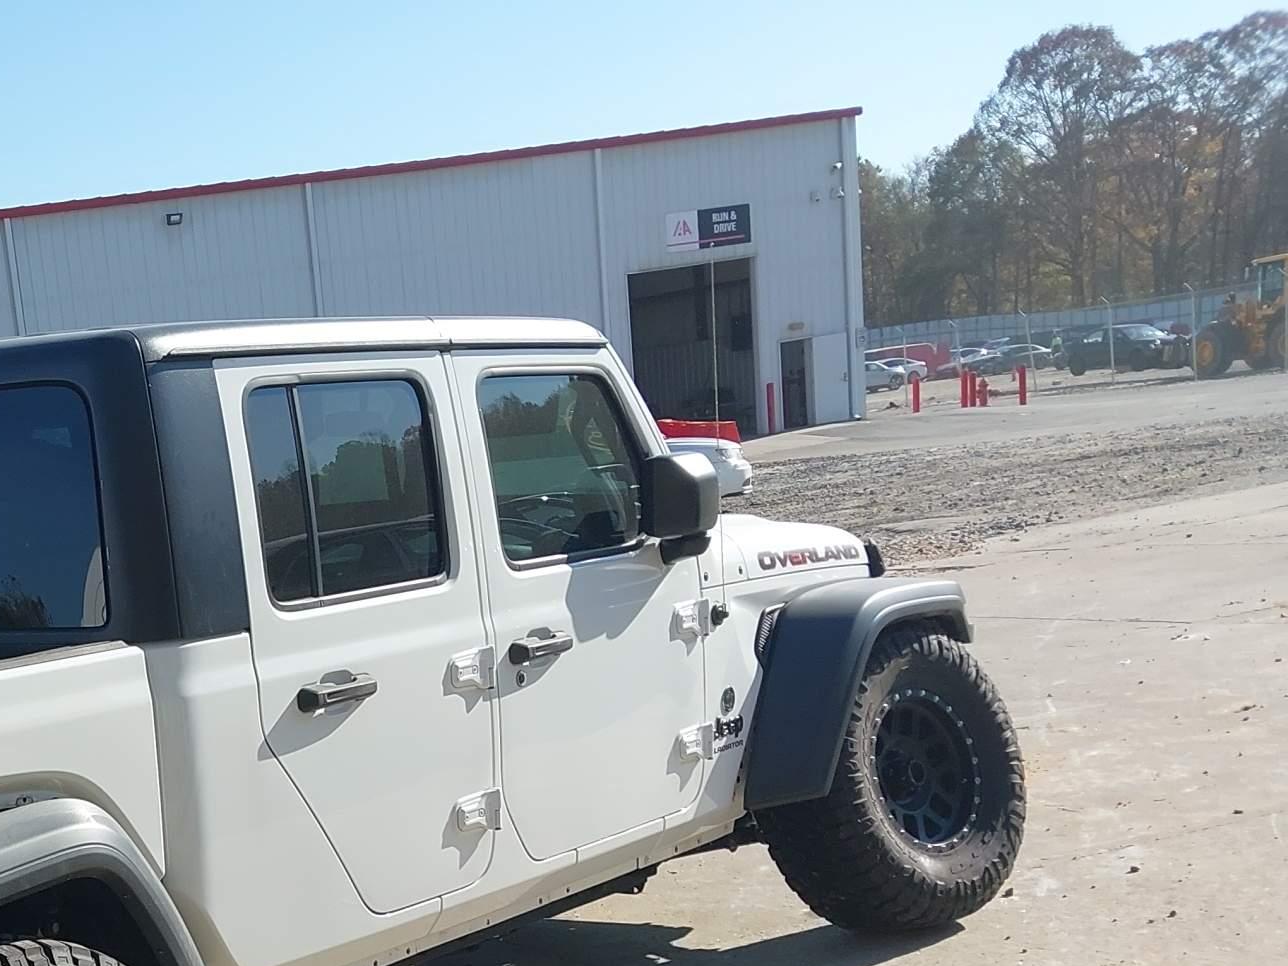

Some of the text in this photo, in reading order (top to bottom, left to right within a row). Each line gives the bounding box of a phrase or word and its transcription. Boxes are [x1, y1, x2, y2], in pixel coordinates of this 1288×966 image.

[712, 211, 737, 222] RUN &
[713, 222, 737, 233] DRIVE
[757, 545, 860, 571] OVERLAND
